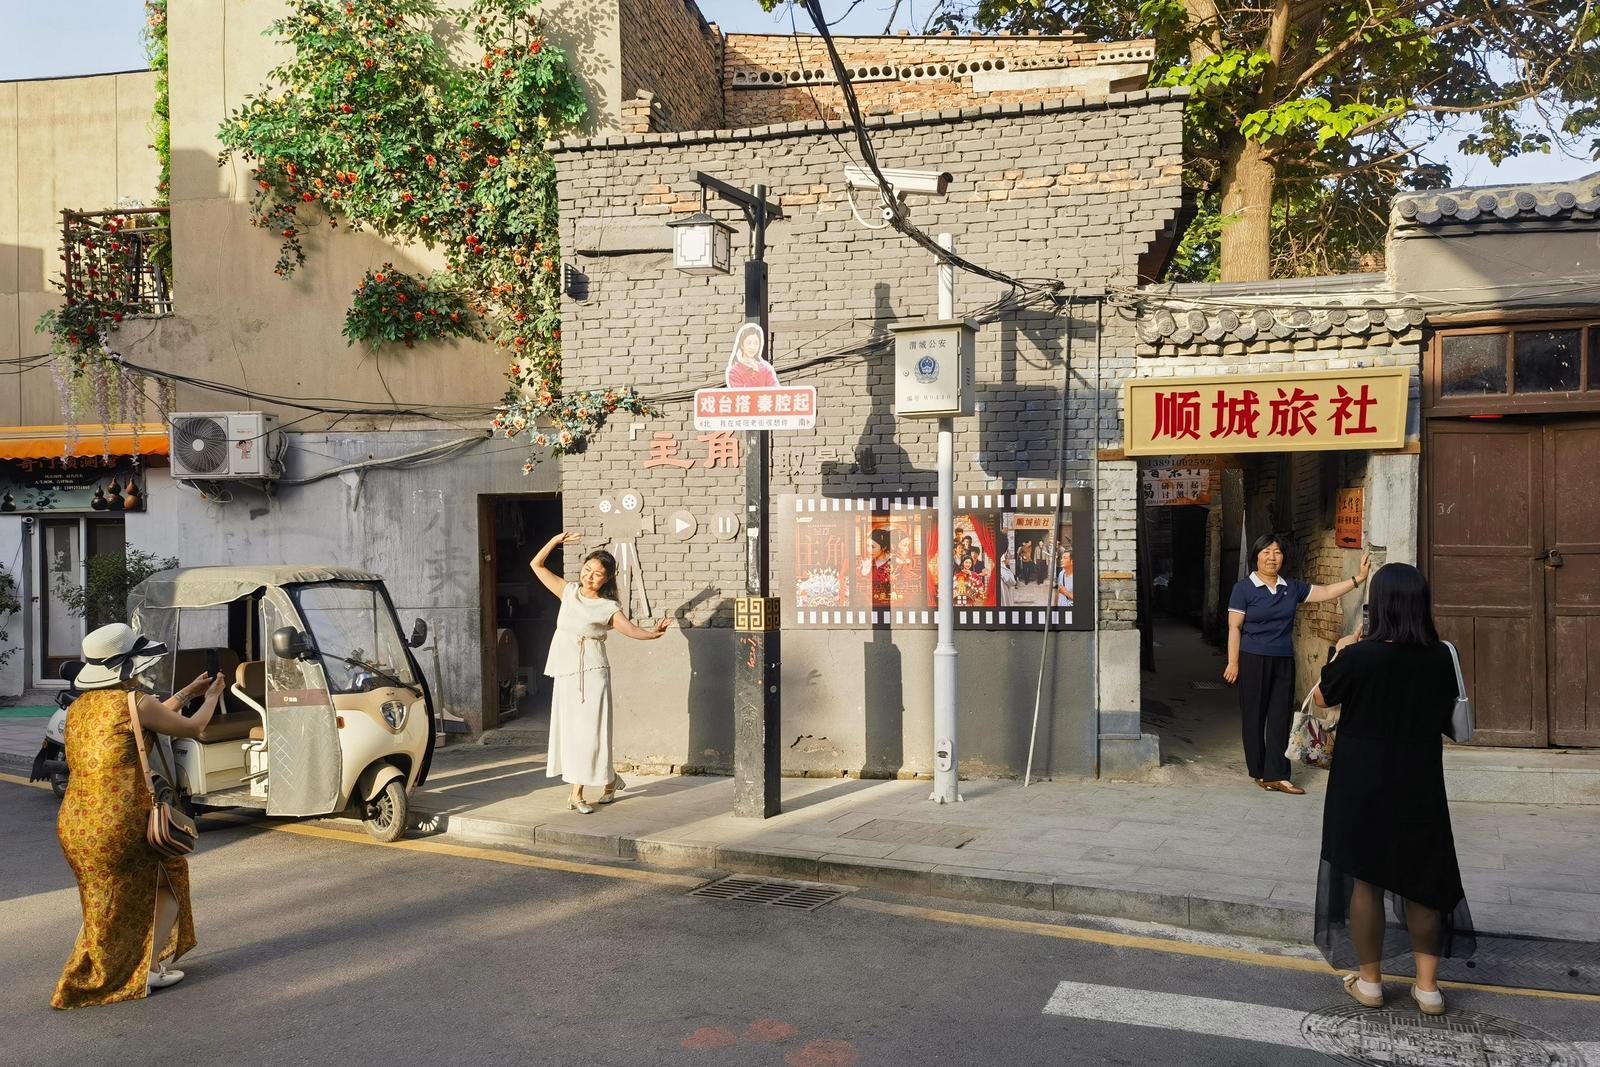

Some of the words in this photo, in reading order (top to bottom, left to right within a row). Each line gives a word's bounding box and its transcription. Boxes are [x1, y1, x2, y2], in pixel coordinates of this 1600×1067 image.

[700, 394, 752, 414] 戏台搭
[757, 393, 810, 413] 秦腔起
[1151, 384, 1378, 441] 顺城旅社
[643, 430, 741, 470] 主角
